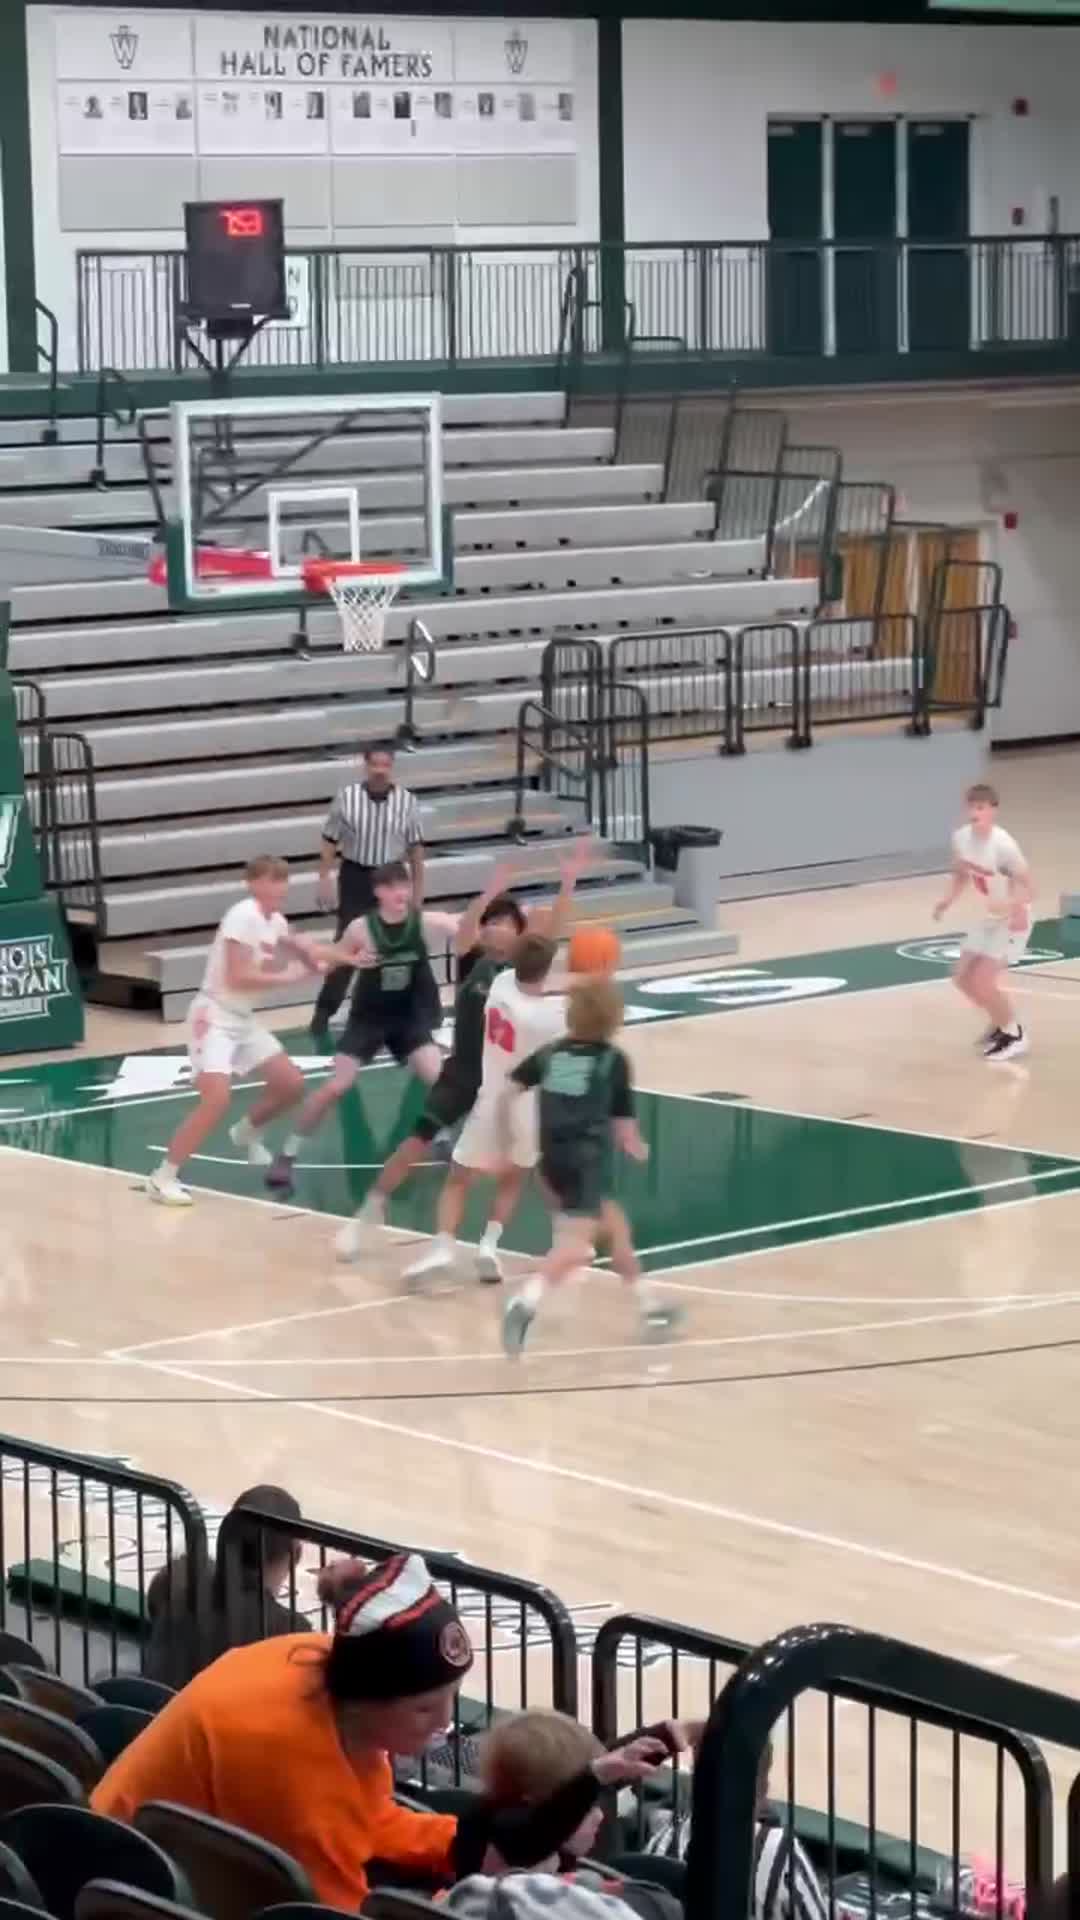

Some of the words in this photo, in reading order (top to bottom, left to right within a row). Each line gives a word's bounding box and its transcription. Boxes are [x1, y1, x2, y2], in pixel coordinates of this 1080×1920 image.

[263, 25, 391, 50] NATIONAL
[221, 51, 286, 76] HALL
[297, 51, 330, 77] OF
[340, 54, 433, 78] FAMERS
